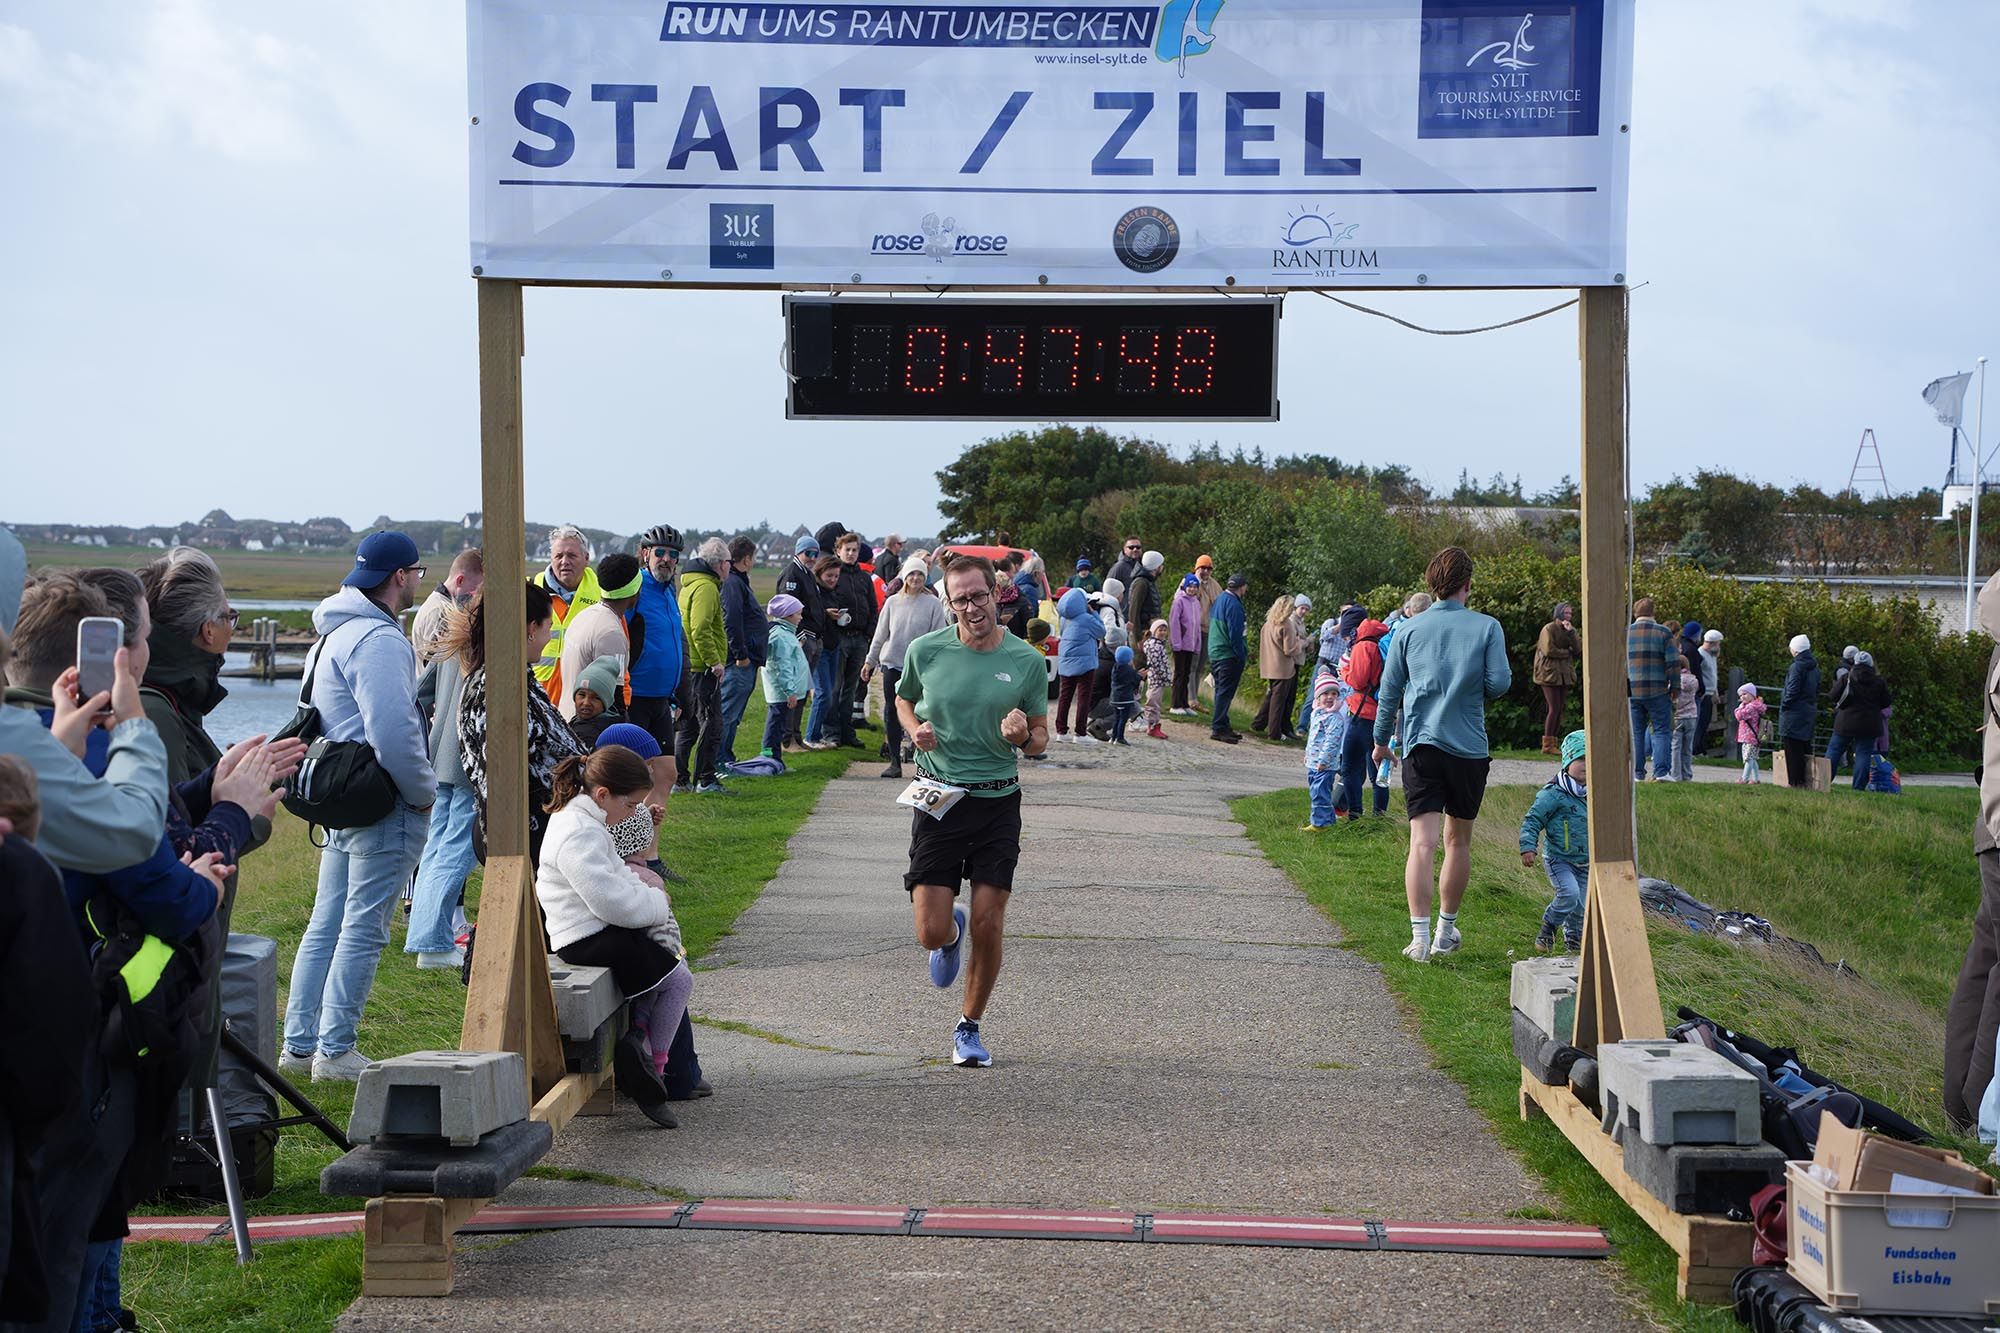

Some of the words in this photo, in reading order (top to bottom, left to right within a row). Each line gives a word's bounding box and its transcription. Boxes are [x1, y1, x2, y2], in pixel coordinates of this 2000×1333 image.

[668, 6, 748, 36] RUN
[758, 8, 838, 38] UMS
[848, 9, 1150, 41] RANTUMBECKEN
[1034, 53, 1148, 67] www.insel-sylt.de
[1491, 73, 1530, 88] SYLT
[1438, 89, 1582, 104] TOURISMUS-SERVICE
[1461, 107, 1556, 120] INSEL-SYLT.DE
[511, 82, 906, 173] START
[958, 91, 1034, 174] /
[1090, 91, 1362, 177] ZIEL
[1117, 208, 1149, 237] FRIESEN
[871, 234, 925, 251] rose
[955, 235, 1008, 251] rose
[1273, 249, 1379, 268] RANTUM
[1314, 270, 1336, 278] SYLT
[906, 328, 1216, 393] 0:47:48
[912, 787, 942, 807] 36
[1884, 1246, 1957, 1261] Fundsachen
[1892, 1270, 1952, 1286] Eisbahn
